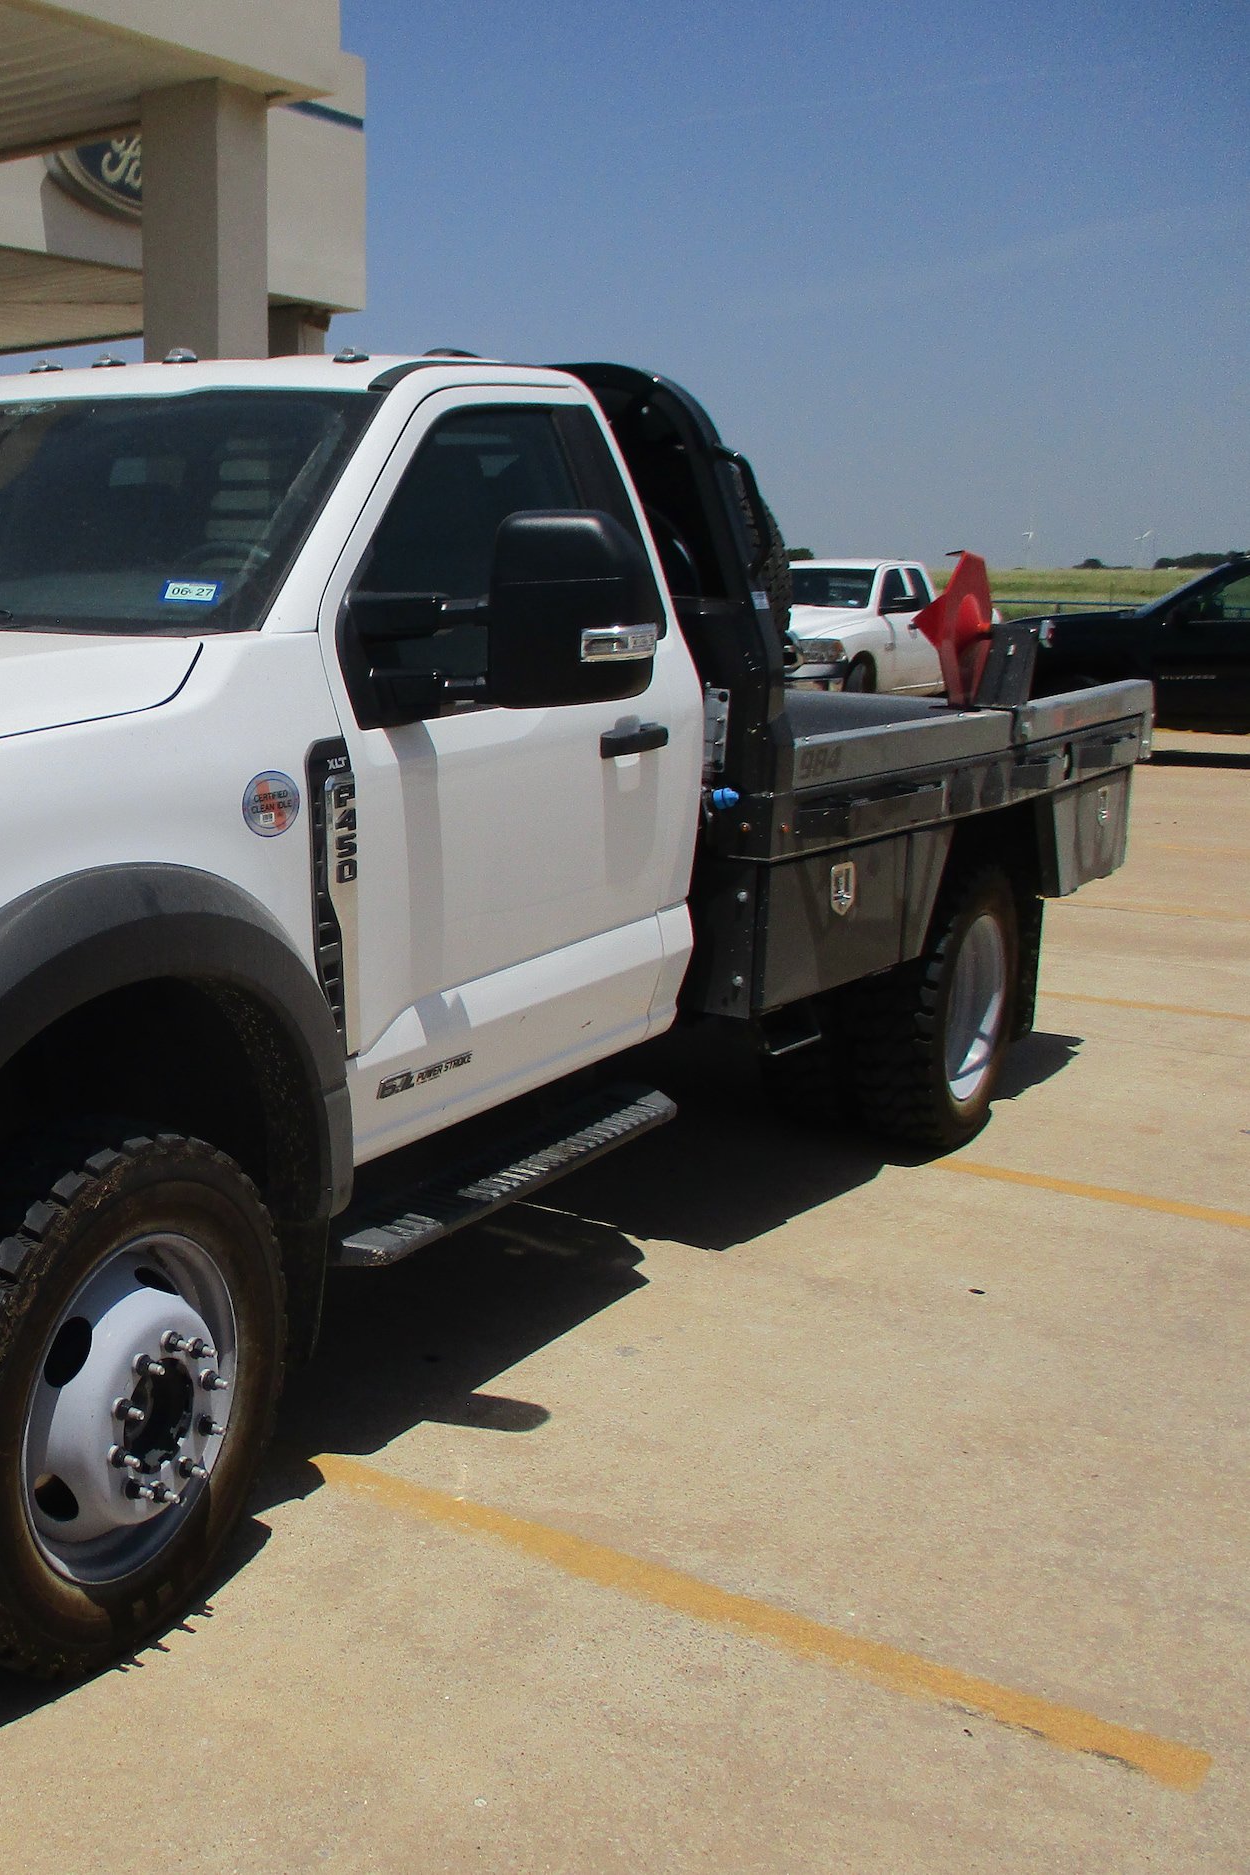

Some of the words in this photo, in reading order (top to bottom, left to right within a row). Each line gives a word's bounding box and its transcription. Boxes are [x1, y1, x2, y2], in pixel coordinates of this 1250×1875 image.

[327, 757, 347, 770] XLT
[253, 789, 288, 803] CERTIFIED
[251, 803, 275, 814] CLEAN
[276, 800, 292, 809] IDLE
[416, 1065, 443, 1083] POWER
[443, 1053, 473, 1072] STROKE
